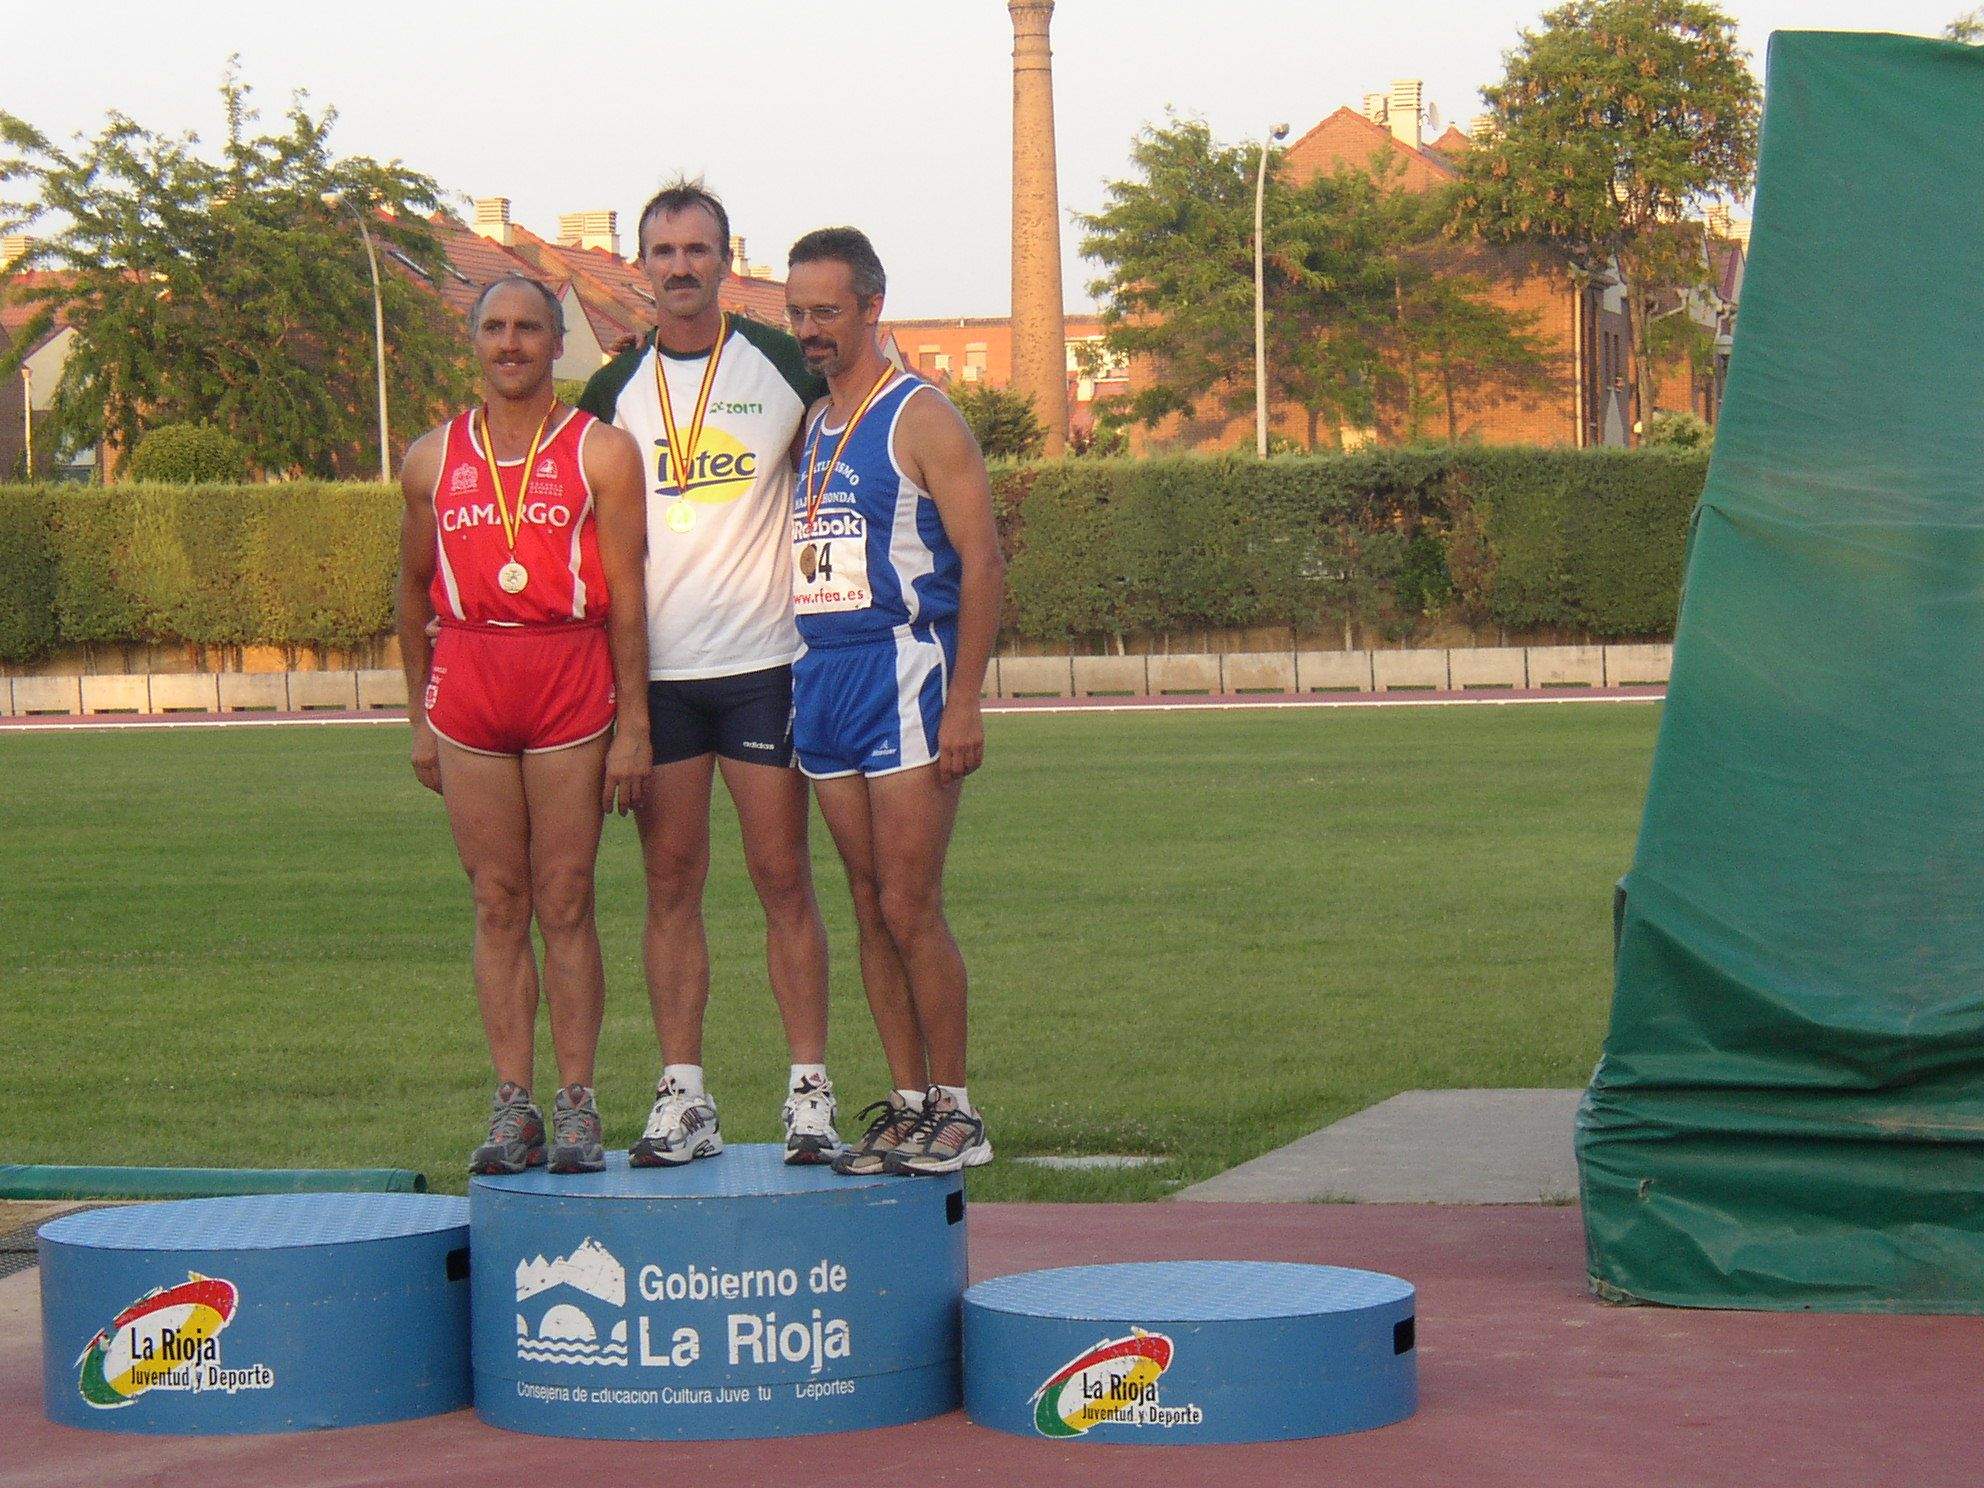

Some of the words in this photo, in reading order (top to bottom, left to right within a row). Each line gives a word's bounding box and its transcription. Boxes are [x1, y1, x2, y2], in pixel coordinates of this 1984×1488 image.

[442, 502, 571, 532] CAMRGO
[742, 741, 775, 751] adidas
[638, 1264, 798, 1301] Gobierno
[809, 1259, 847, 1294] de
[131, 1327, 154, 1361] La
[162, 1327, 216, 1367] Rioja
[639, 1315, 699, 1367] La
[727, 1307, 852, 1375] Rioja
[131, 1365, 190, 1386] Juventud
[195, 1370, 202, 1391] y
[209, 1365, 271, 1391] Deporte
[1083, 1372, 1103, 1400] La
[1111, 1373, 1157, 1406] Rioja
[572, 1386, 588, 1402] de
[661, 1386, 712, 1405] Cultura
[1082, 1405, 1134, 1422] Juventud
[1138, 1410, 1145, 1426] y
[1150, 1405, 1200, 1425] Deporte
